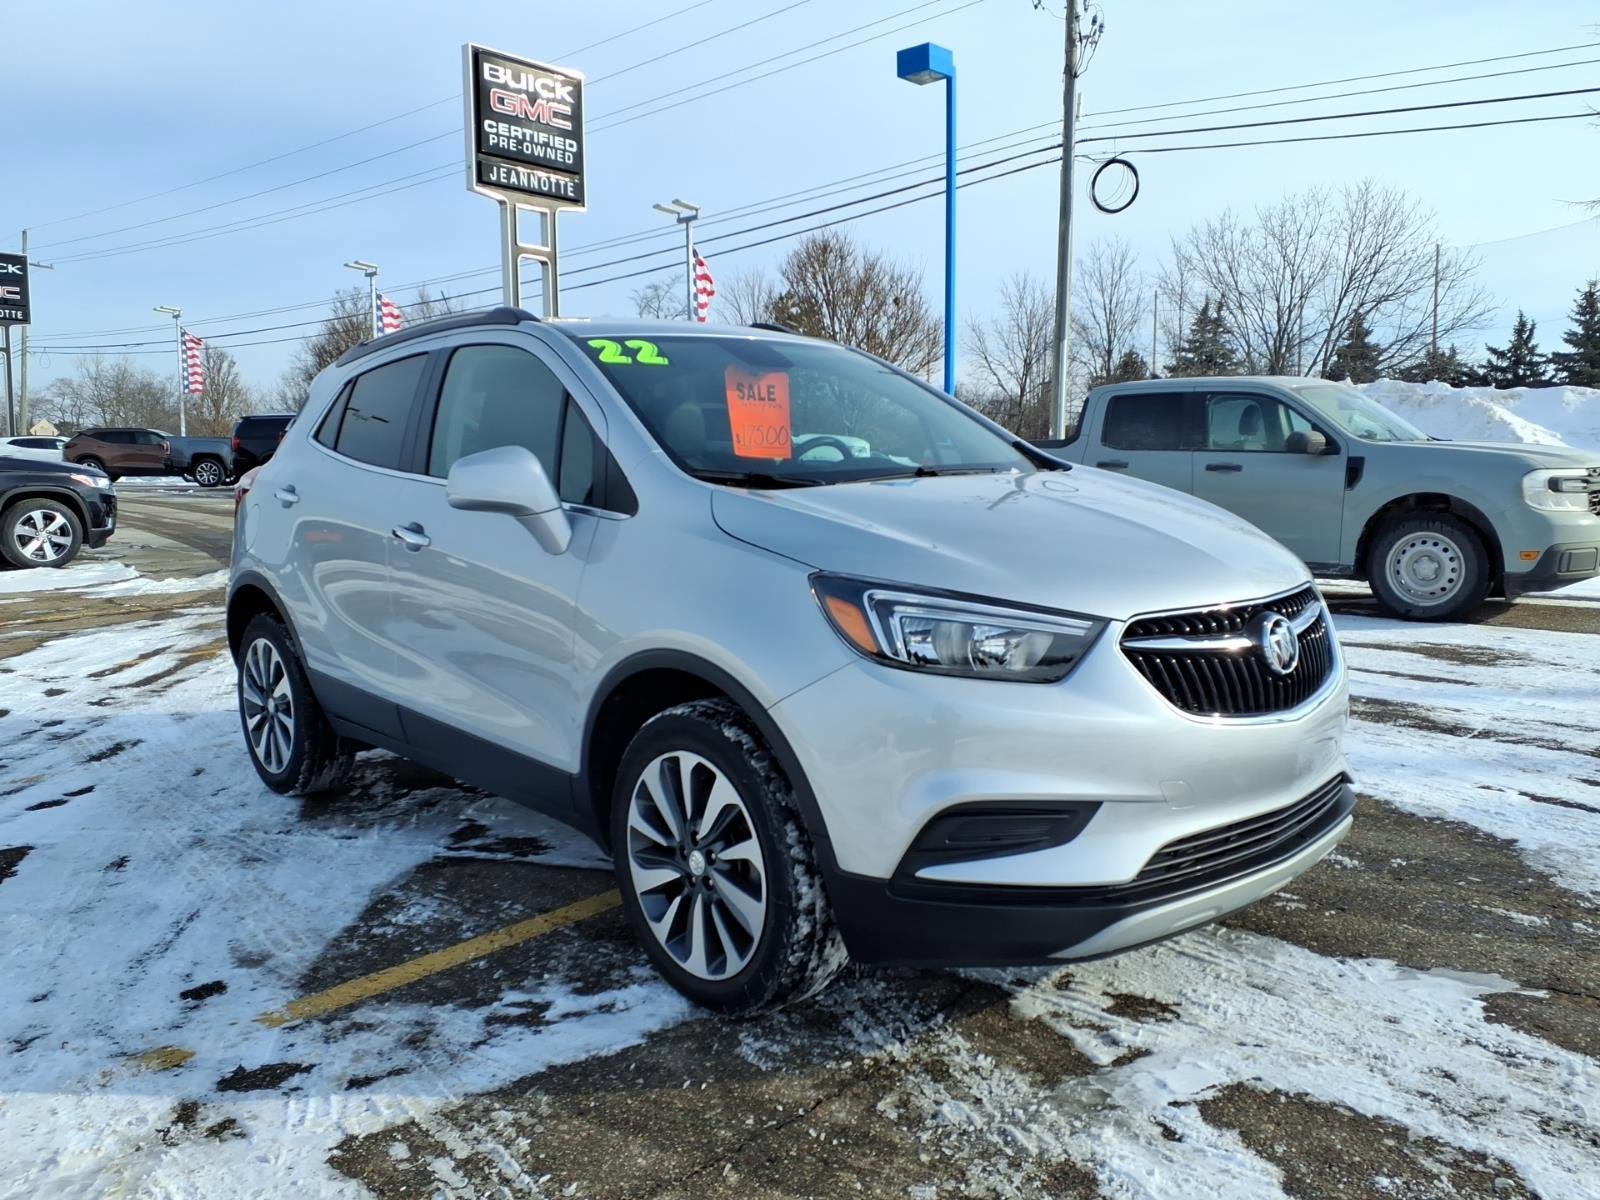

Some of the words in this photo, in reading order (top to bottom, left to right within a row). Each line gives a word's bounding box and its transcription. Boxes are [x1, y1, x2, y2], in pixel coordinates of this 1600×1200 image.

[483, 62, 575, 103] BUICK
[490, 88, 572, 130] GMC
[484, 119, 577, 153] CERTIFIED
[489, 134, 573, 164] PRE-OWNED
[489, 166, 575, 196] JEANNOTTE
[587, 339, 669, 365] 22
[736, 382, 776, 402] SALE
